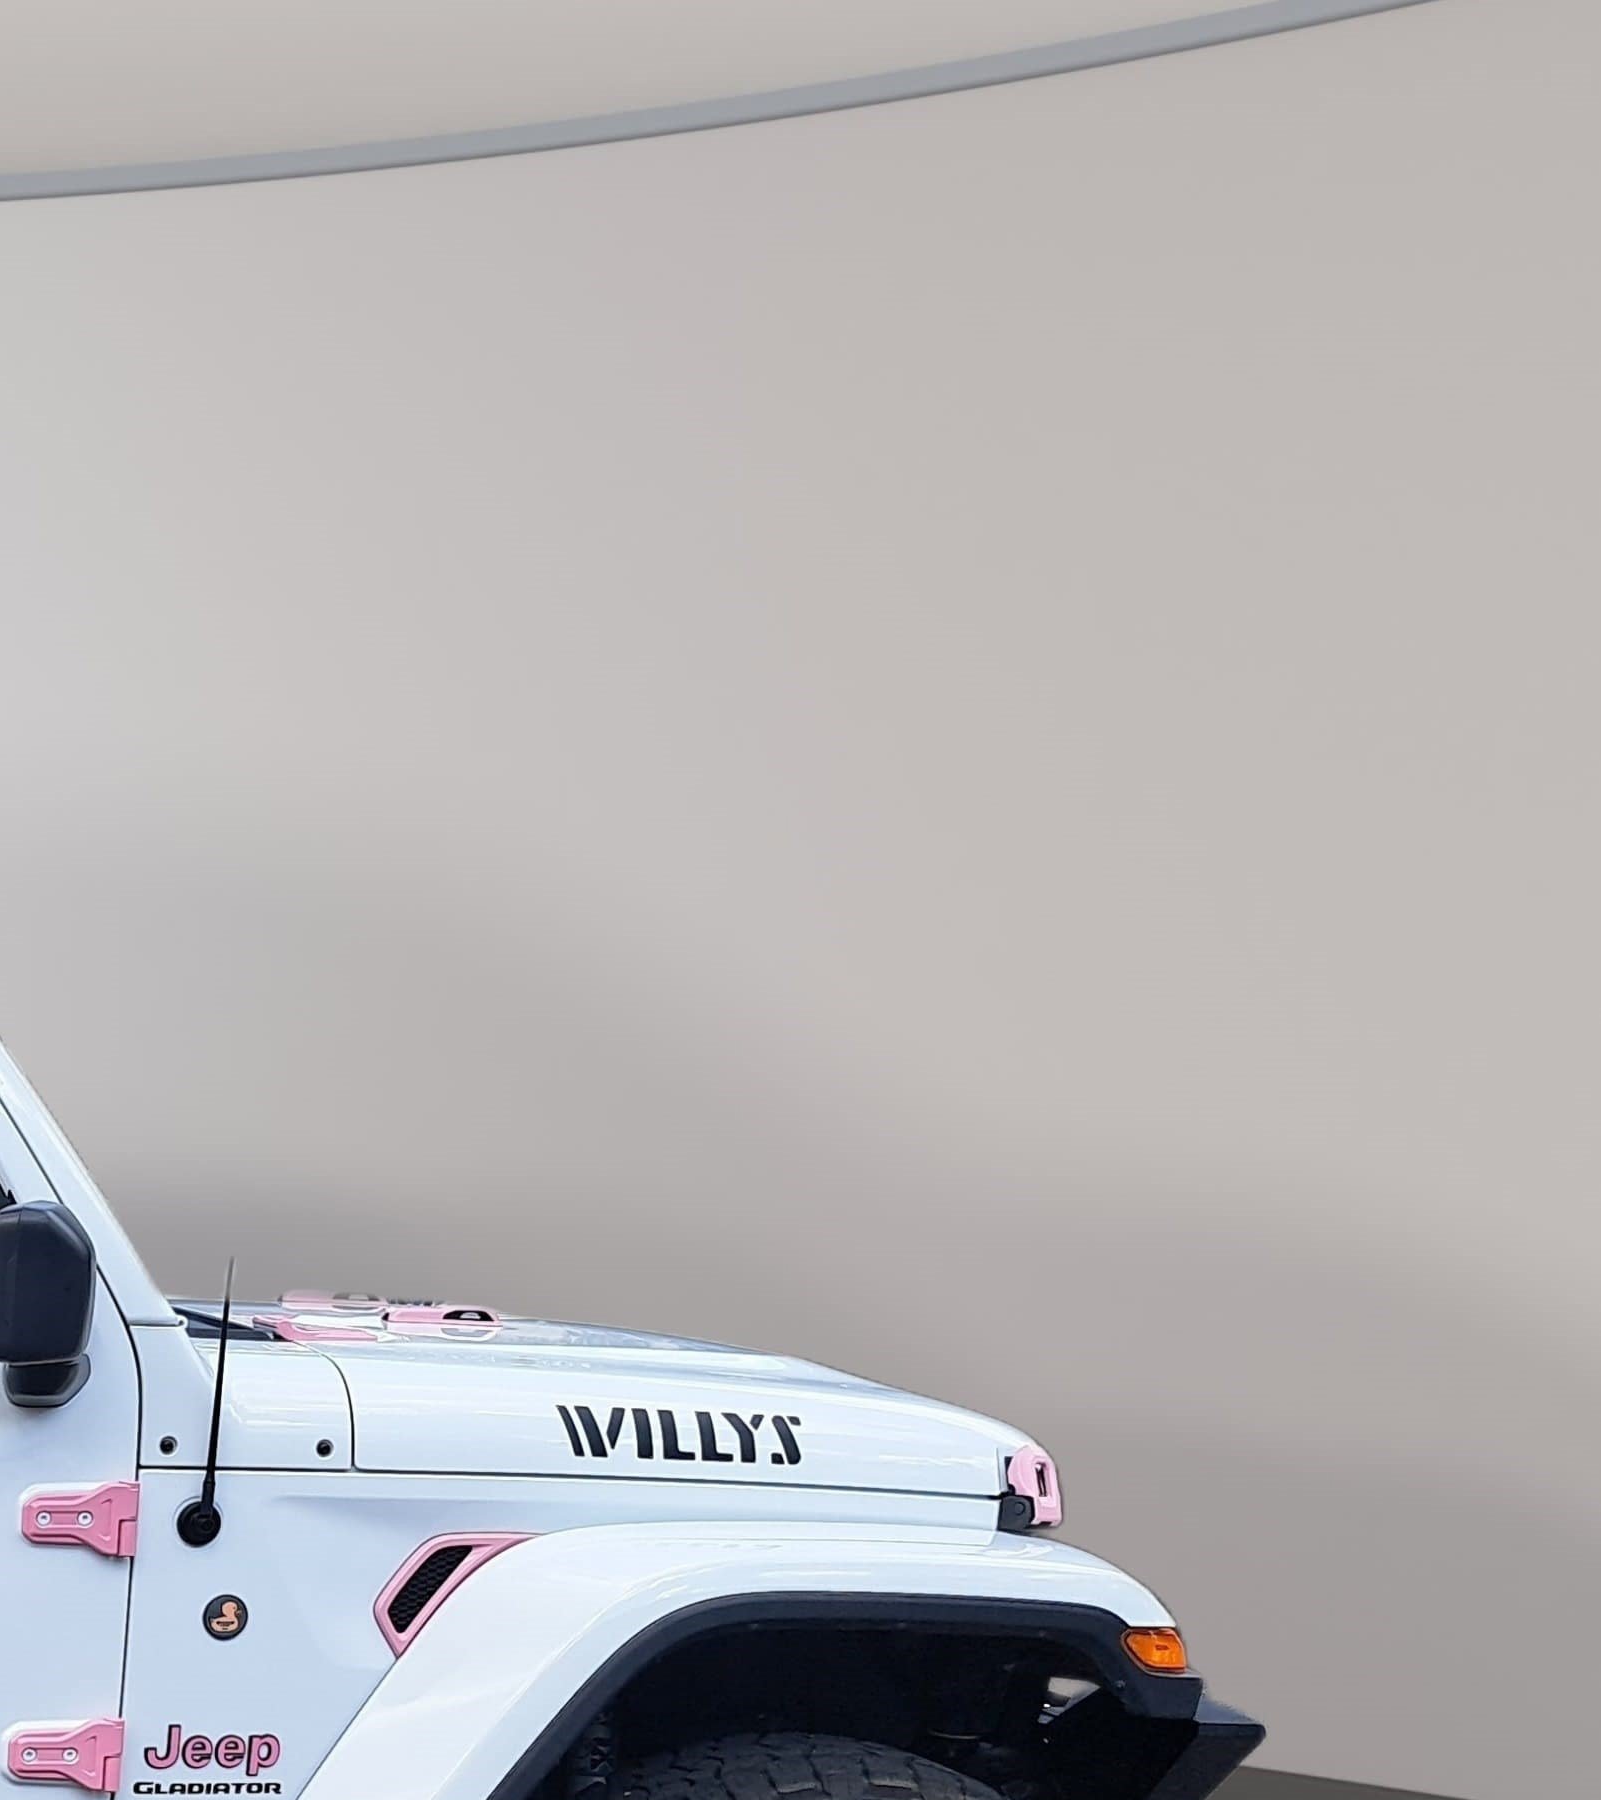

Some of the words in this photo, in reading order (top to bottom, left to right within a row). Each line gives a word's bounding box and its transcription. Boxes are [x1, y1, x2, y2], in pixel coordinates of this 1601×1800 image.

[556, 1405, 801, 1465] WILLYS
[144, 1724, 280, 1776] Jeep
[133, 1782, 281, 1794] GLADIATOR
